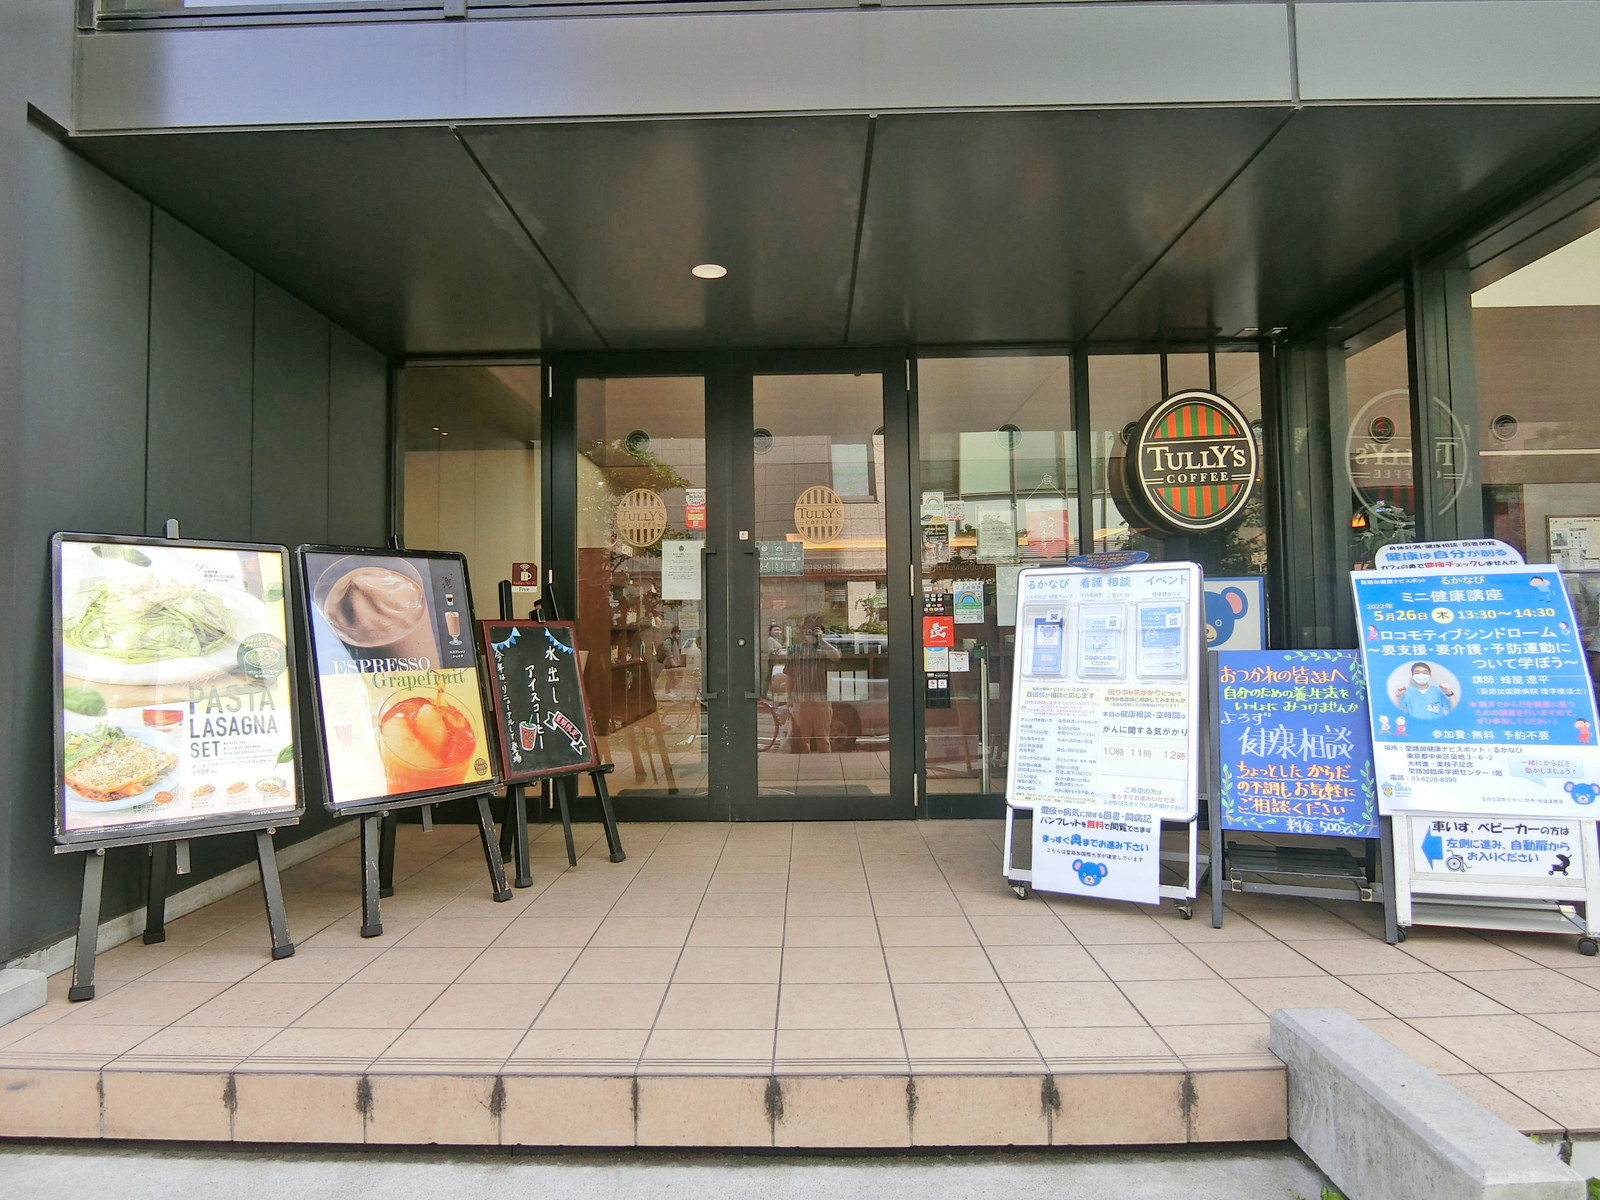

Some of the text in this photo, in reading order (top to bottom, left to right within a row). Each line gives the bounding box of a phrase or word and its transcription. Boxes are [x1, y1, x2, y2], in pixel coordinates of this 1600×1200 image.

[1146, 444, 1247, 472] TULLY'S
[1166, 472, 1229, 485] COFFEE
[620, 510, 665, 522] TULLY'S
[797, 507, 842, 519] TULLY'S
[1028, 574, 1187, 589] るかなび 看護 相談 イベント
[1440, 576, 1485, 585] るかなび
[1401, 588, 1505, 603] ミニ健康講座
[1374, 608, 1556, 622] 5月26日 木 13:30～14:30
[1380, 626, 1558, 641] ロコモティブシンドローム
[332, 656, 431, 675] ESPRESSO
[372, 668, 466, 691] Grapefruit
[544, 646, 561, 704] 水出し
[1220, 665, 1349, 685] おつかれの皆さまへ
[188, 684, 276, 715] PASTA
[1026, 692, 1095, 700] 看護師が相談に応じます
[1107, 688, 1182, 697] 困り事や気がかりについて
[525, 664, 544, 750] アイスコーヒー
[1102, 710, 1186, 720] 本日の健康相談・空時間は
[1220, 711, 1272, 726] よろず
[189, 714, 279, 739] LASAGNA
[1102, 725, 1188, 737] がんに関する気がかり
[1237, 723, 1355, 762] 健康相談
[1432, 729, 1550, 741] 参加費：無料 予約不要
[190, 741, 220, 758] SET
[1103, 747, 1186, 761] 10時 11時 12時
[1520, 760, 1571, 768] 一緒にからだを
[1411, 776, 1458, 784] 03-6226-6390
[1124, 786, 1162, 796] ご希望の方は
[1237, 797, 1346, 816] ご相談ください
[1040, 816, 1151, 834] パンフレットを無料で閲覧できます
[1432, 820, 1571, 836] 車いす、ベビーカーの方は
[1042, 833, 1149, 852] まっすぐ奥までお進み下さい
[1446, 838, 1571, 852] 左側に進み、自動扉から
[1467, 851, 1540, 863] お入りください
